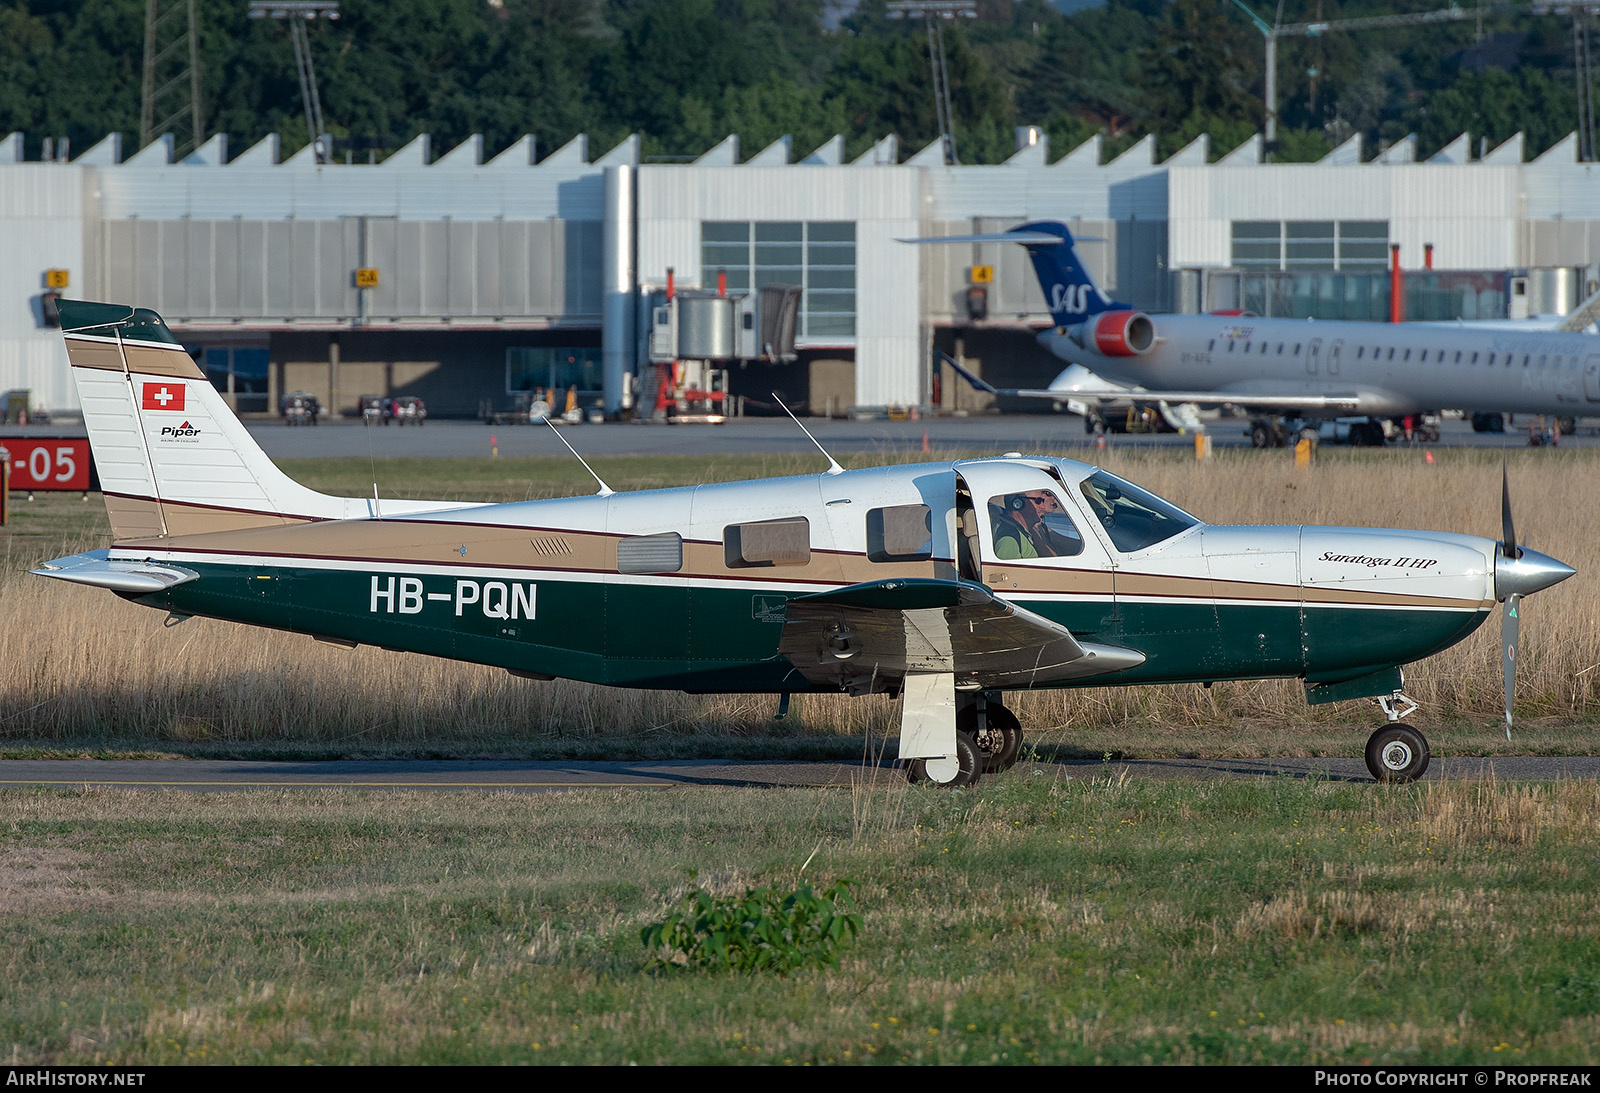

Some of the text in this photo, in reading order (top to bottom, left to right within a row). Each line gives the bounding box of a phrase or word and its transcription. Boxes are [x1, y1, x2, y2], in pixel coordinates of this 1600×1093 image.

[1050, 284, 1092, 314] SAS
[161, 427, 201, 438] Piper
[1318, 551, 1438, 569] Saratoga II HP
[370, 575, 537, 621] HB-PQN
